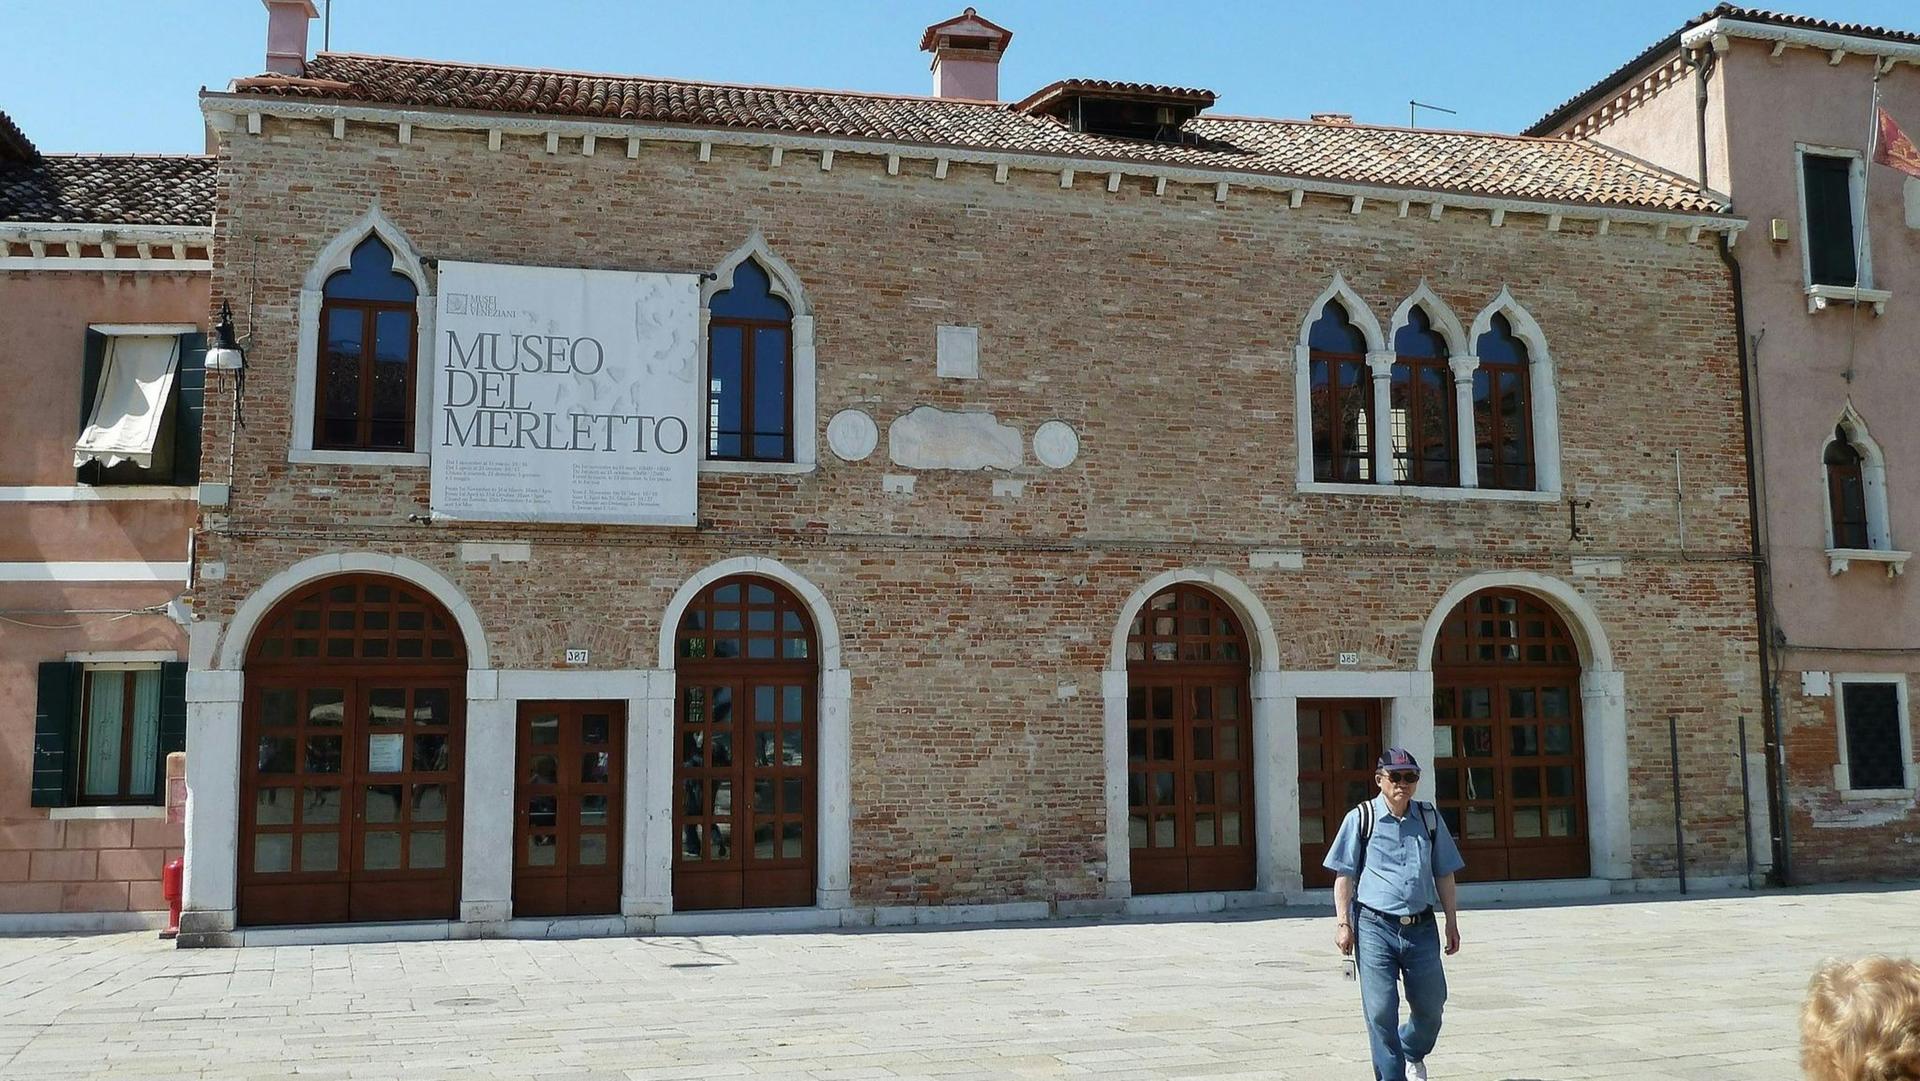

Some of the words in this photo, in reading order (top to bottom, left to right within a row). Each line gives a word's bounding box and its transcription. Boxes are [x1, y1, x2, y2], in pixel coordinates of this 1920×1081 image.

[470, 309, 517, 318] VENEZIANI
[445, 330, 604, 375] MUSEO
[443, 369, 533, 411] DEL
[442, 407, 688, 454] MERLETTO
